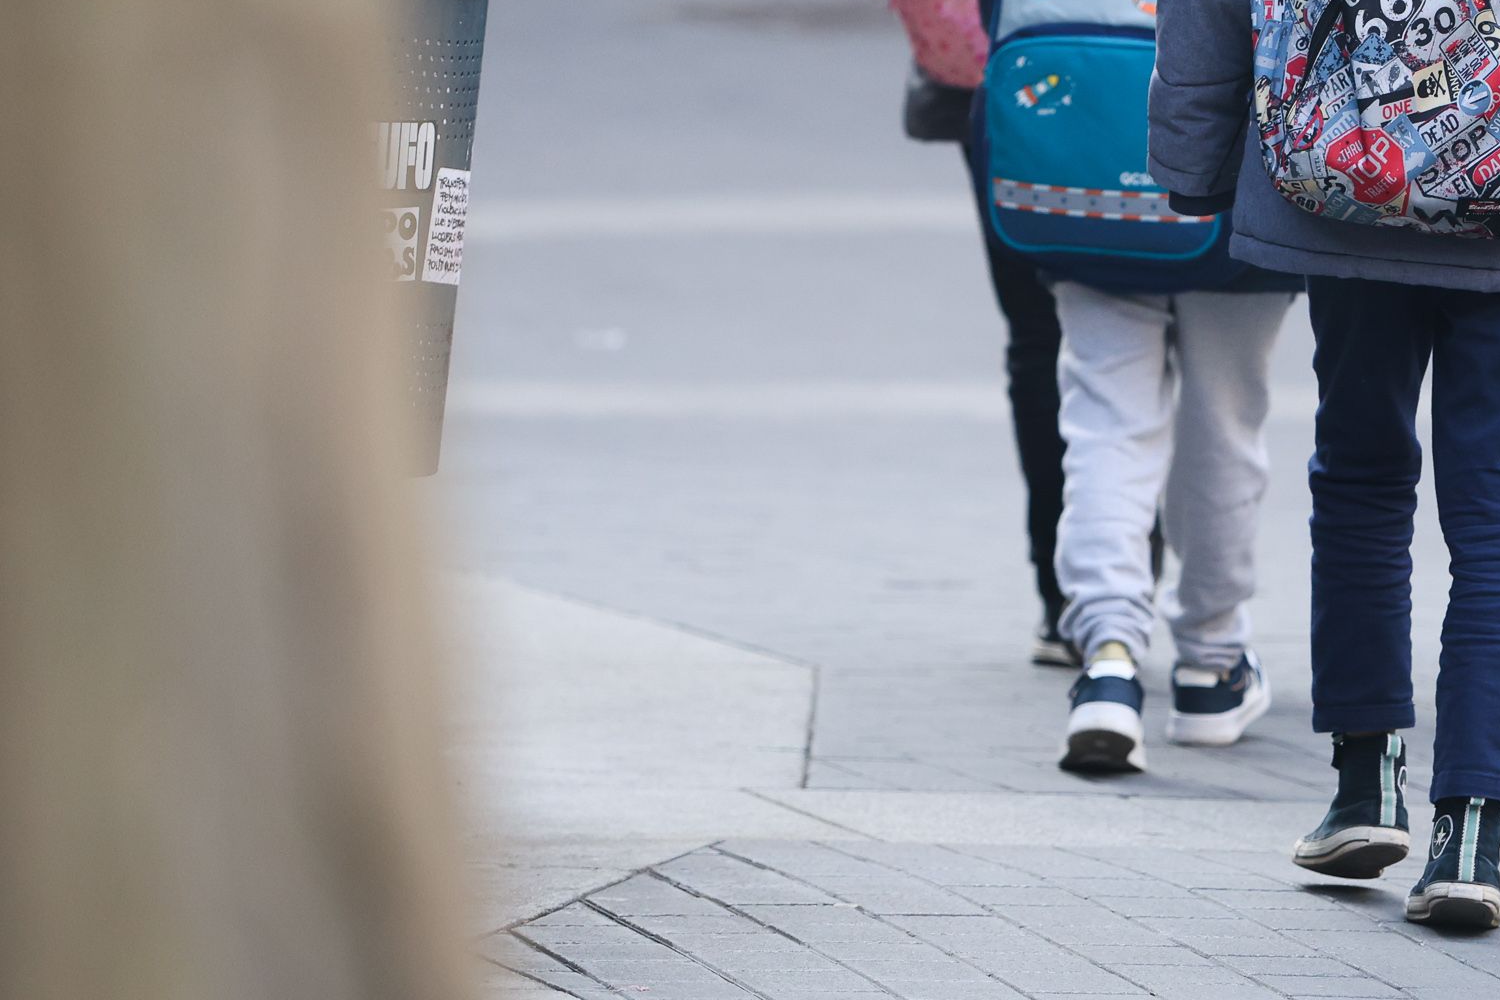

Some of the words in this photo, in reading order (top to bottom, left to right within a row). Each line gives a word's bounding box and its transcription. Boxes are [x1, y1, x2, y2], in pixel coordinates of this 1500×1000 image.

[1410, 6, 1456, 47] 30
[1382, 99, 1413, 120] ONE
[1421, 113, 1460, 148] DEAD
[1339, 139, 1364, 163] THRU
[1363, 170, 1398, 199] TRAFFIC
